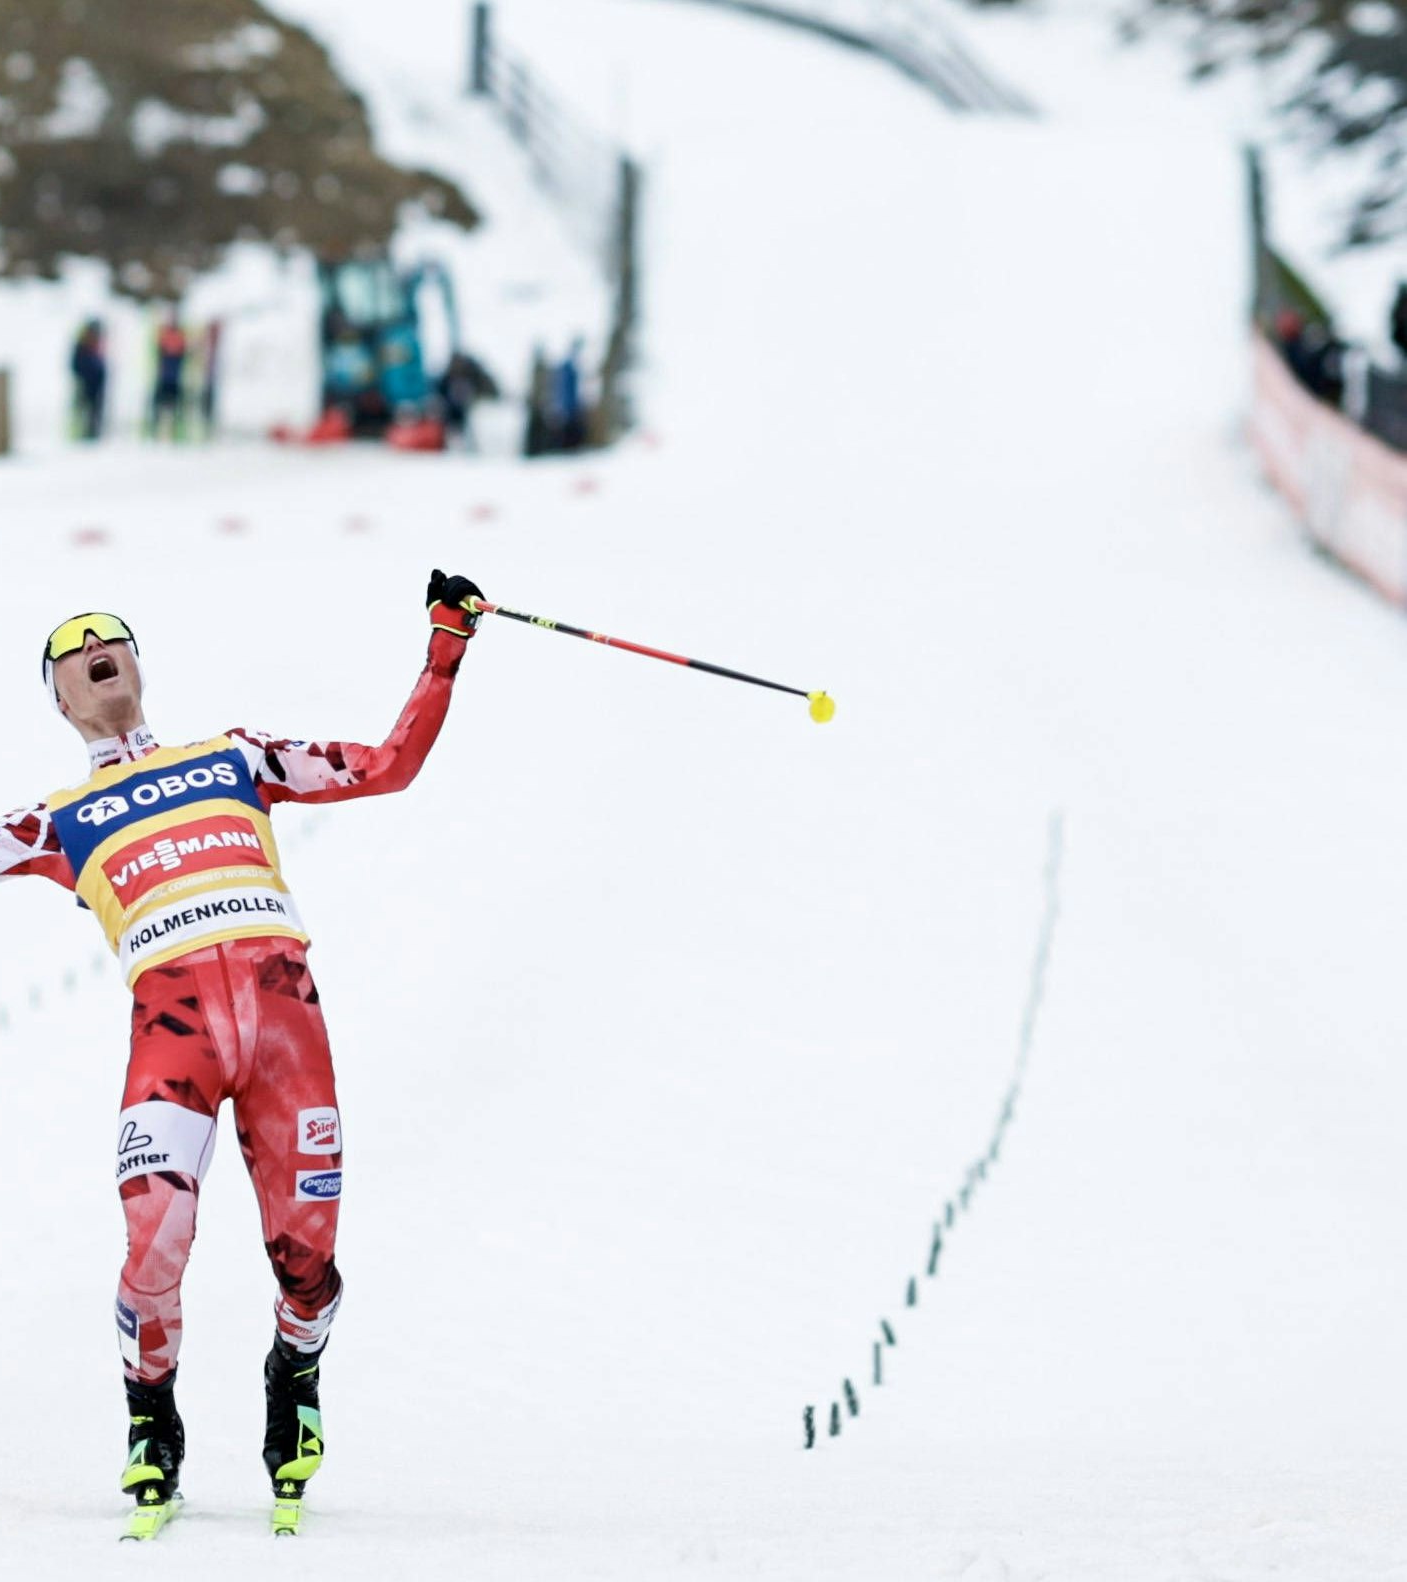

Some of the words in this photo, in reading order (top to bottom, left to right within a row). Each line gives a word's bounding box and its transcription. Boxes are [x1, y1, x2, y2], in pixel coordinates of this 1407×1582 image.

[131, 762, 238, 806] OBOS
[110, 831, 261, 888] VIESSMANN
[130, 897, 286, 952] HOLMENKOLLEN
